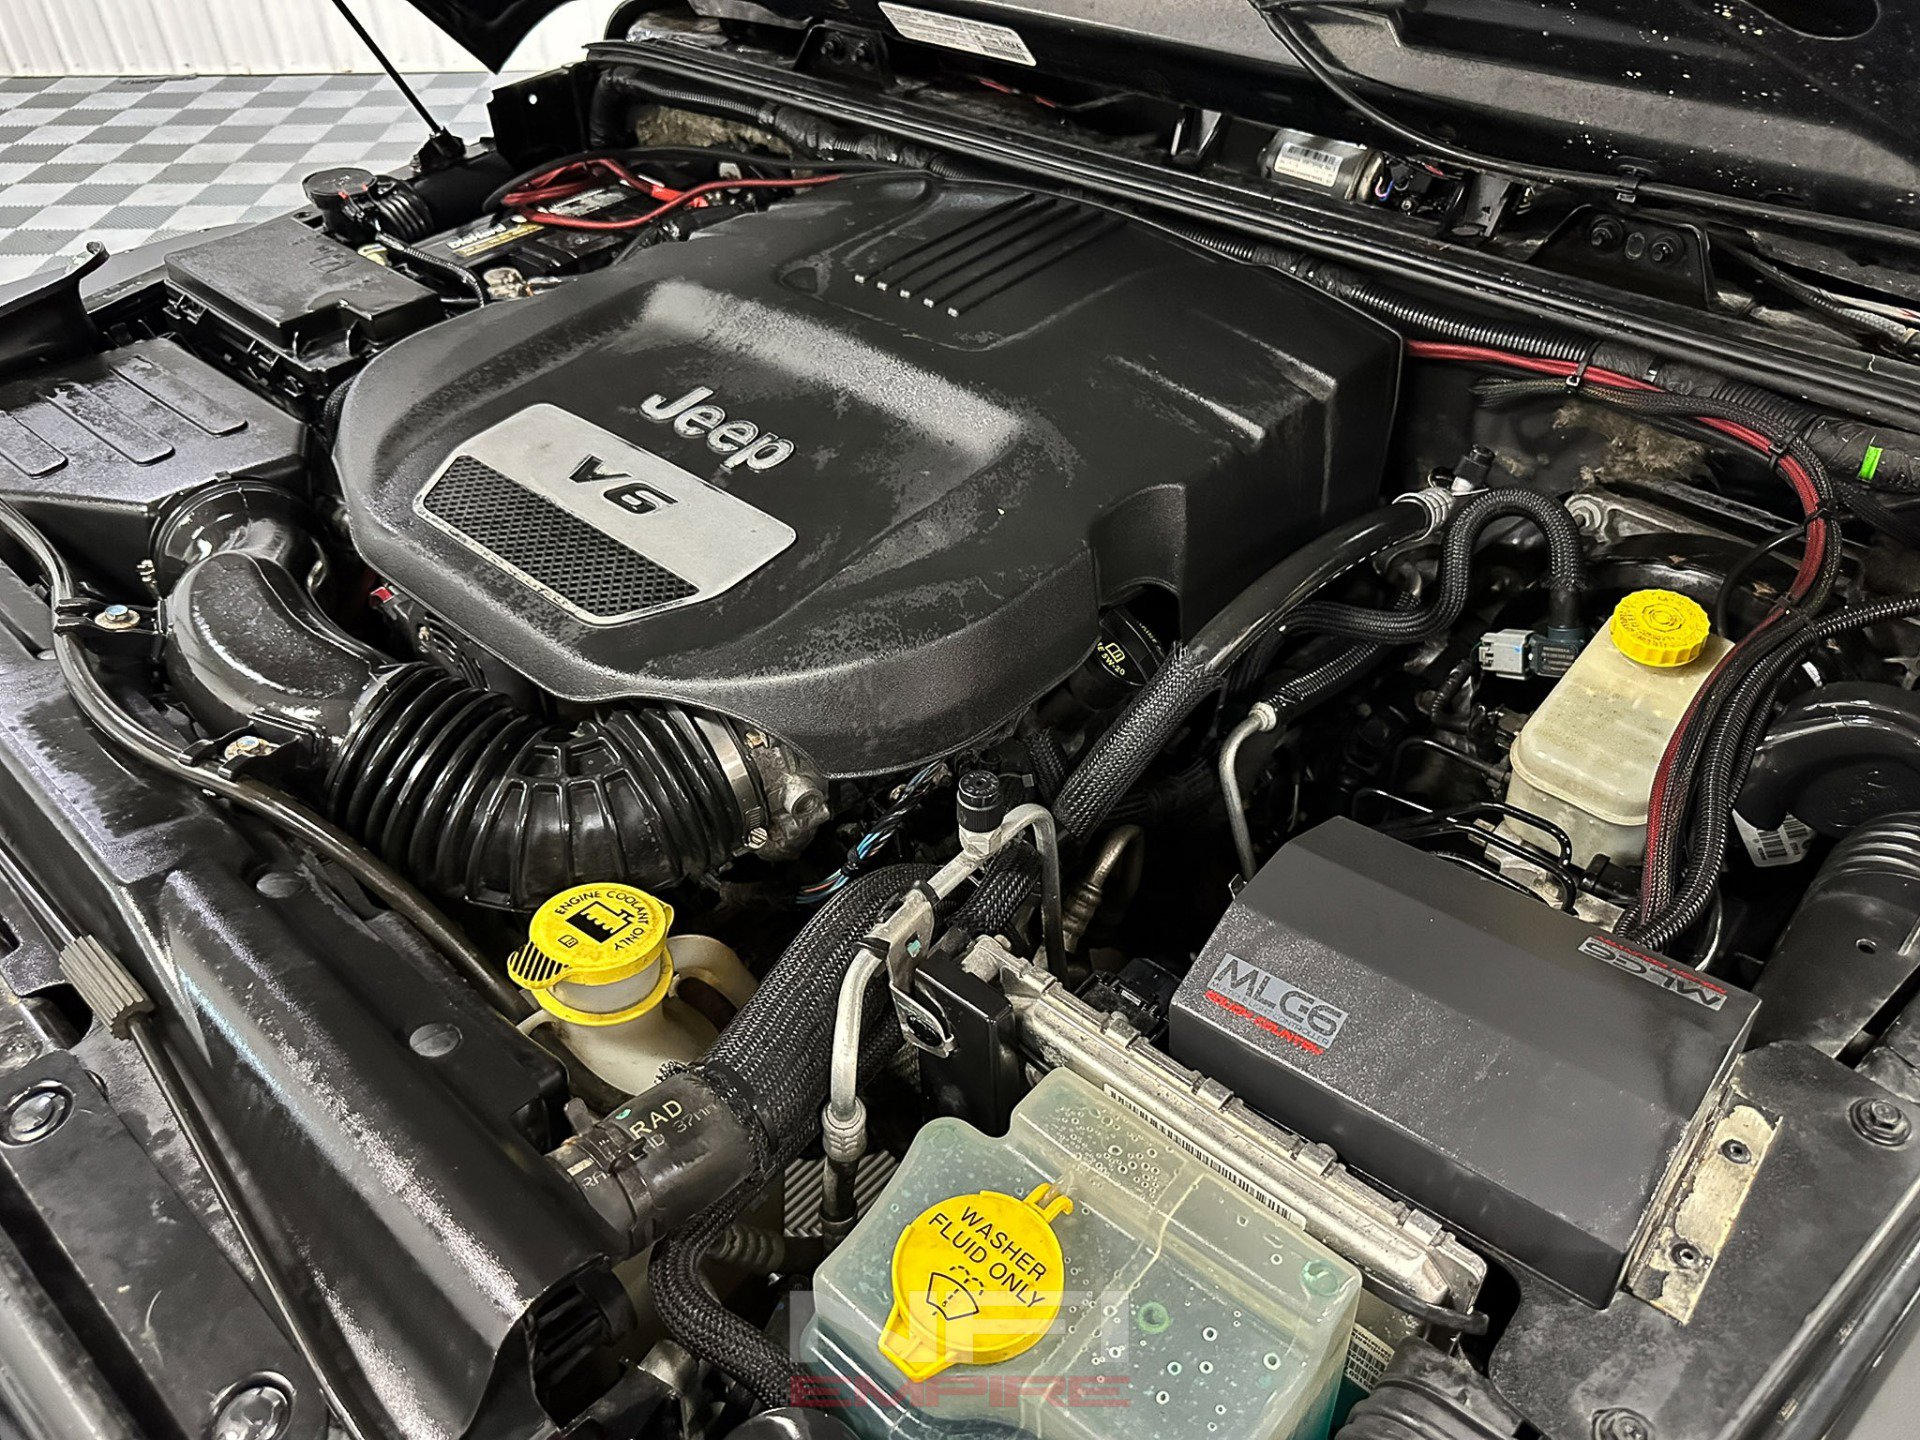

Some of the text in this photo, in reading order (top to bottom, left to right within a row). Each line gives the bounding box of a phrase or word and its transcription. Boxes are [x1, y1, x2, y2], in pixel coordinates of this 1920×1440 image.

[639, 386, 795, 474] Jeep
[569, 454, 678, 515] V6
[1101, 653, 1126, 675] 5W-20
[555, 890, 649, 951] ENGINE COOLANT ONLY
[629, 1100, 683, 1139] RAD
[928, 1212, 1045, 1308] FLUID ONLY
[961, 1206, 1047, 1281] WASHER
